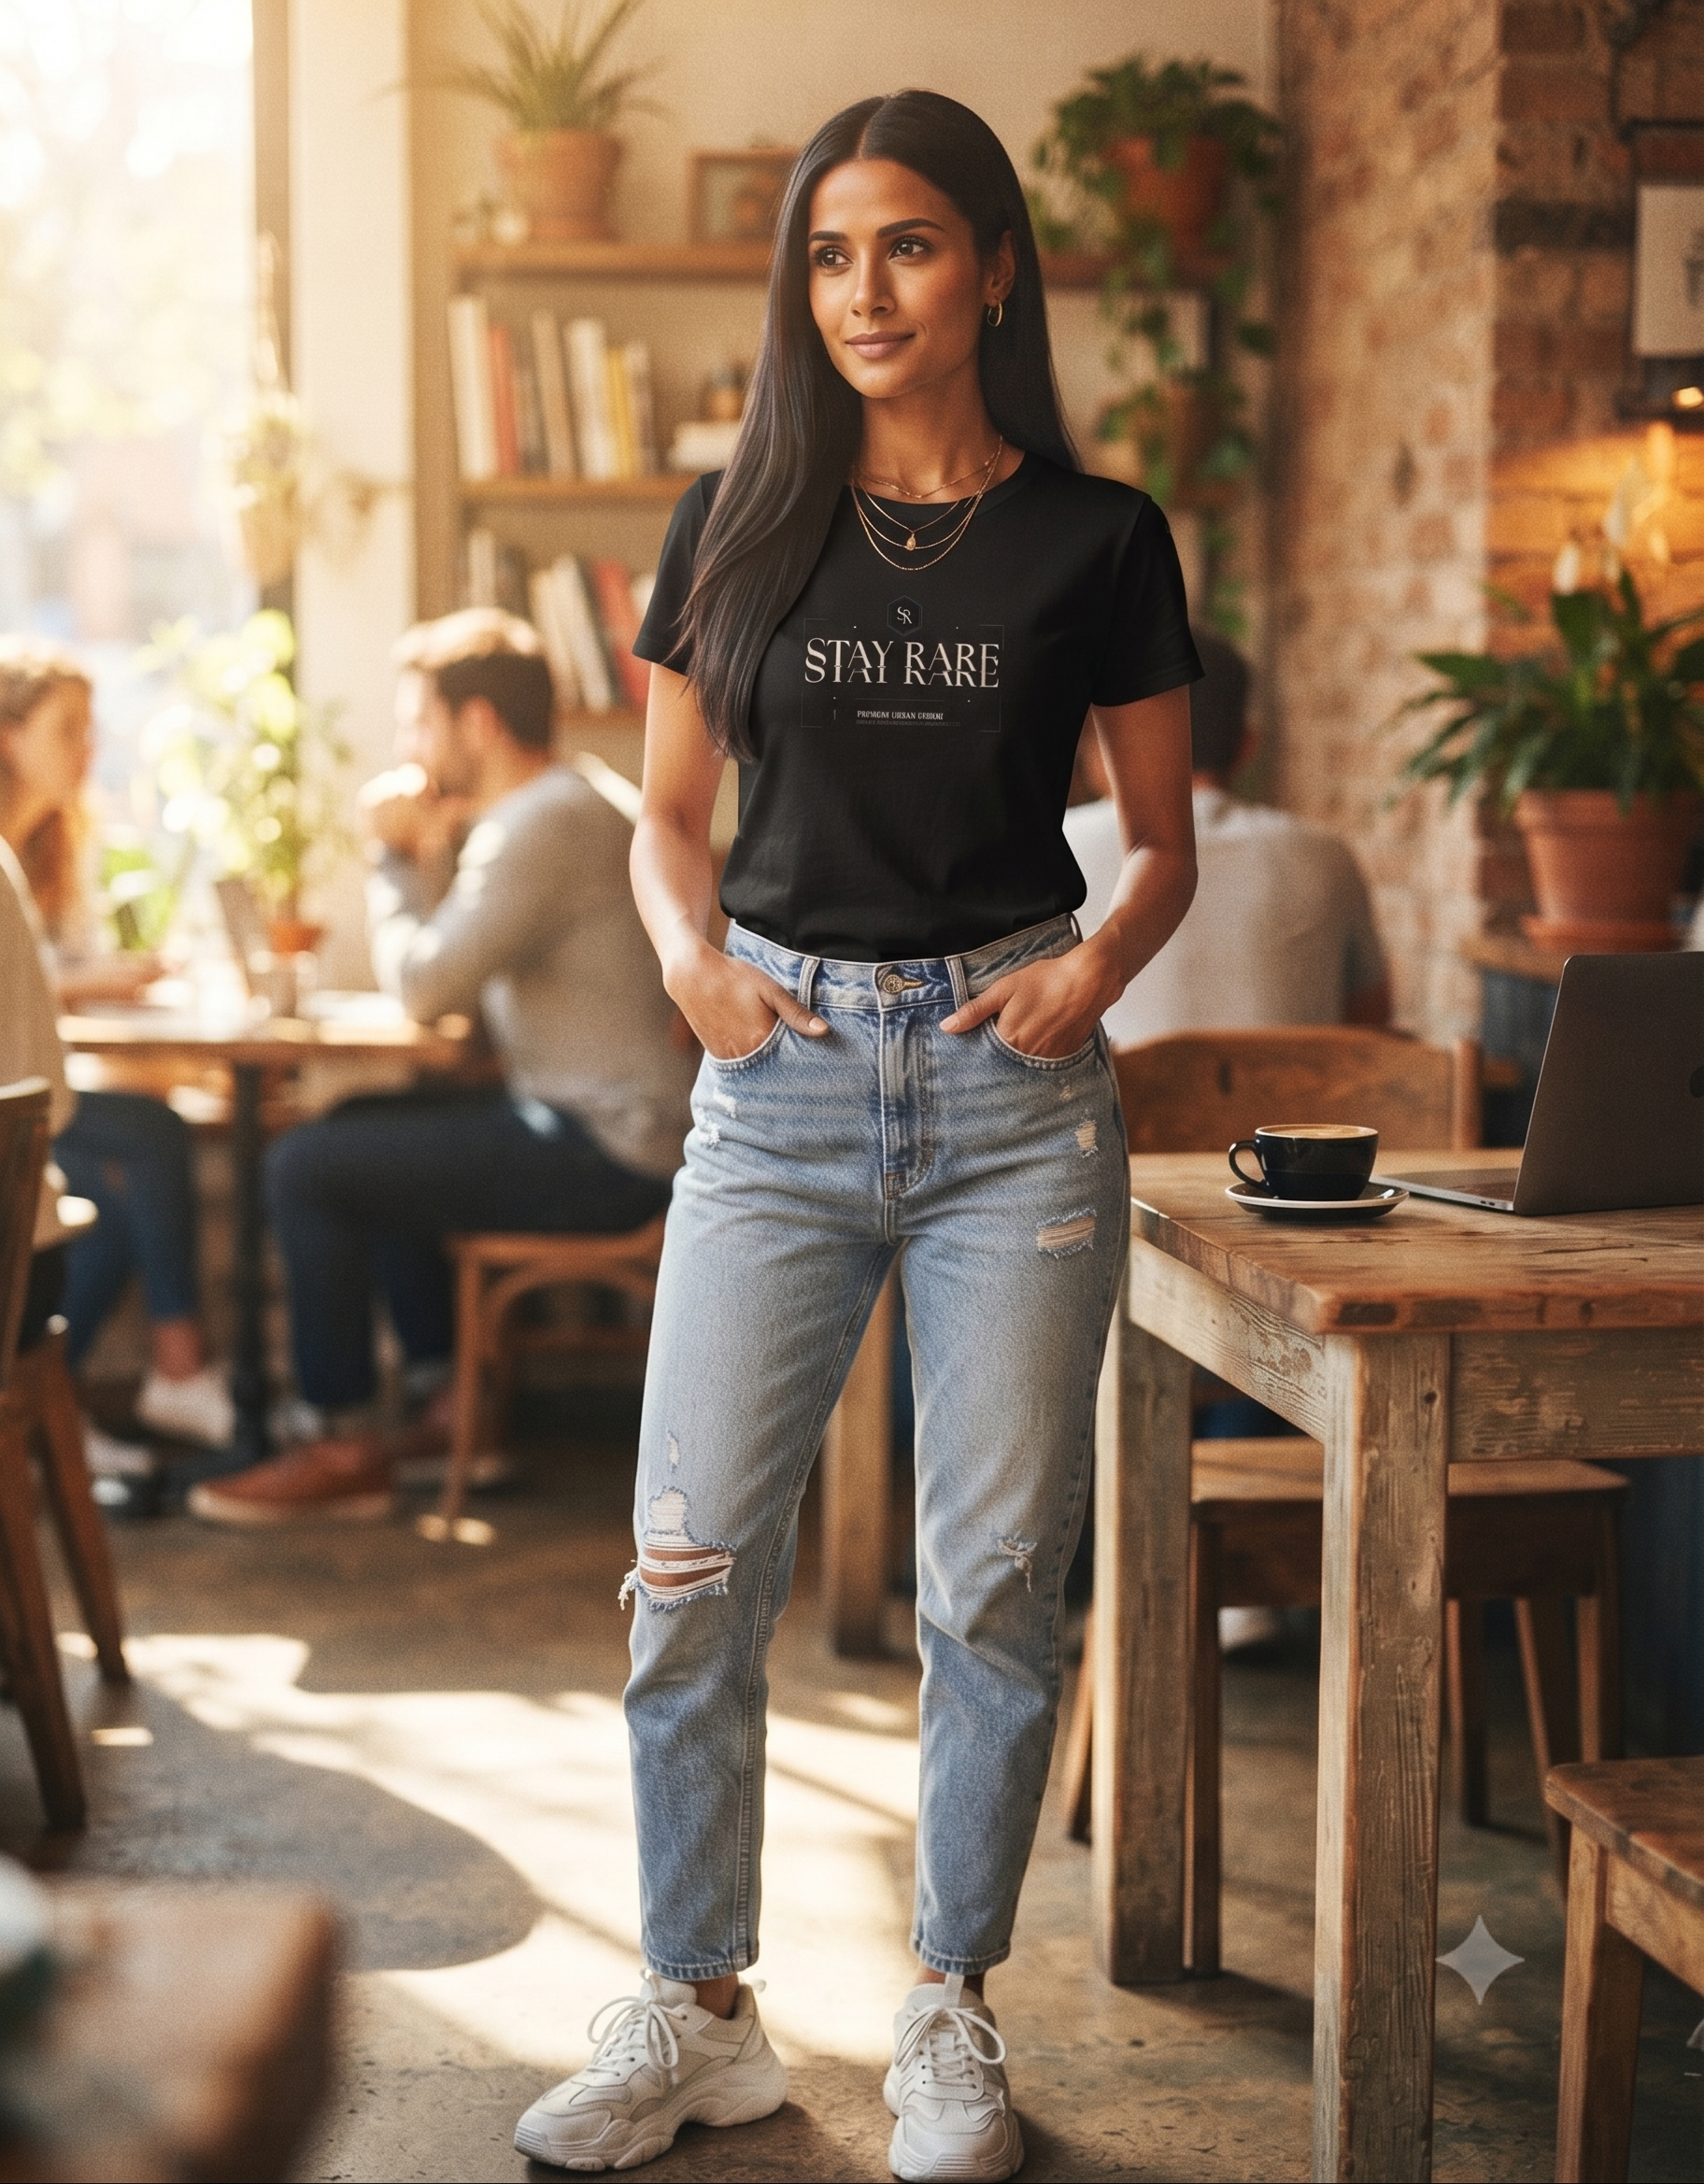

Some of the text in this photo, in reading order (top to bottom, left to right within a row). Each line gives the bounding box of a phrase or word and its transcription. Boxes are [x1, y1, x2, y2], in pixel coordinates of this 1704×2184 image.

[897, 606, 913, 625] SR
[804, 637, 1000, 688] STAY RARE
